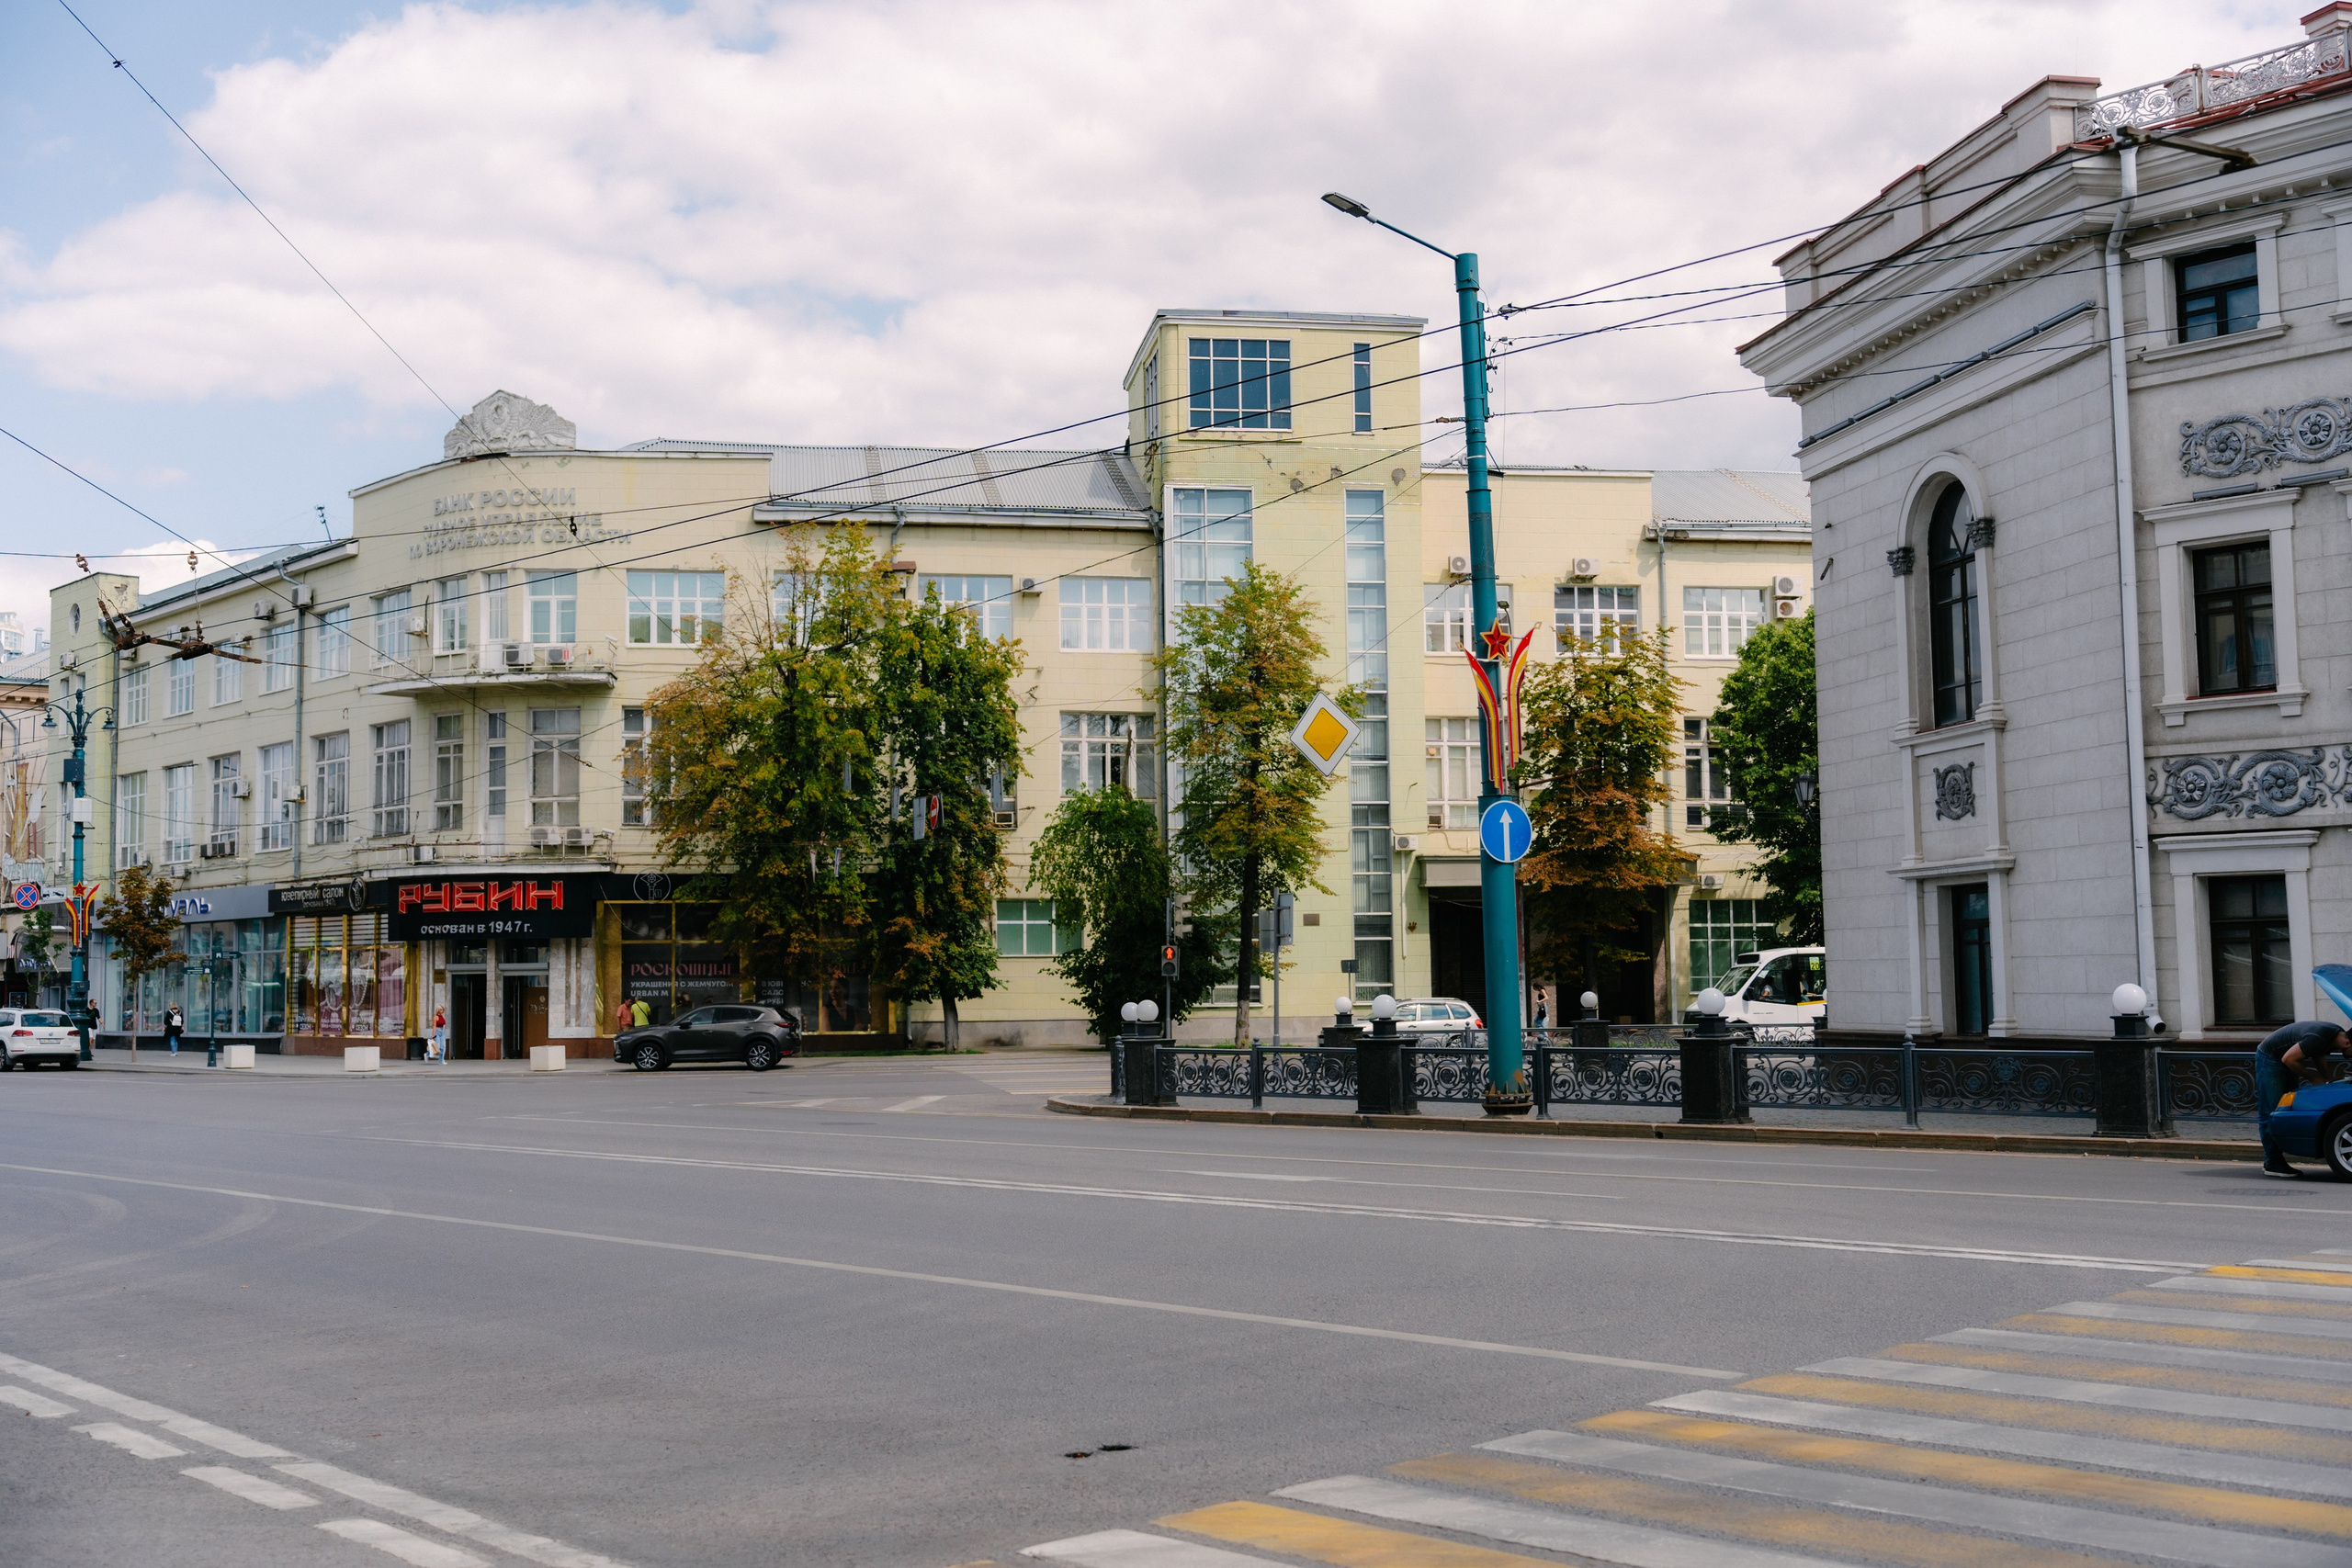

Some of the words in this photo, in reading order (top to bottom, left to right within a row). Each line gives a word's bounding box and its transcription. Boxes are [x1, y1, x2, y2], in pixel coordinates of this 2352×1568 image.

[433, 492, 475, 516] БАНК
[480, 487, 576, 509] РОССИИ
[423, 515, 477, 539] ГЛАВНОЕ
[481, 511, 603, 529] УПРАВЛЕНИЕ
[409, 543, 423, 559] ПО
[425, 526, 535, 556] ВОРОНЕЖСКОЙ
[540, 527, 632, 544] ОБЛАСТИ
[322, 886, 344, 898] салон
[399, 880, 564, 914] РУБИН
[421, 923, 475, 935] основан
[477, 923, 486, 933] в
